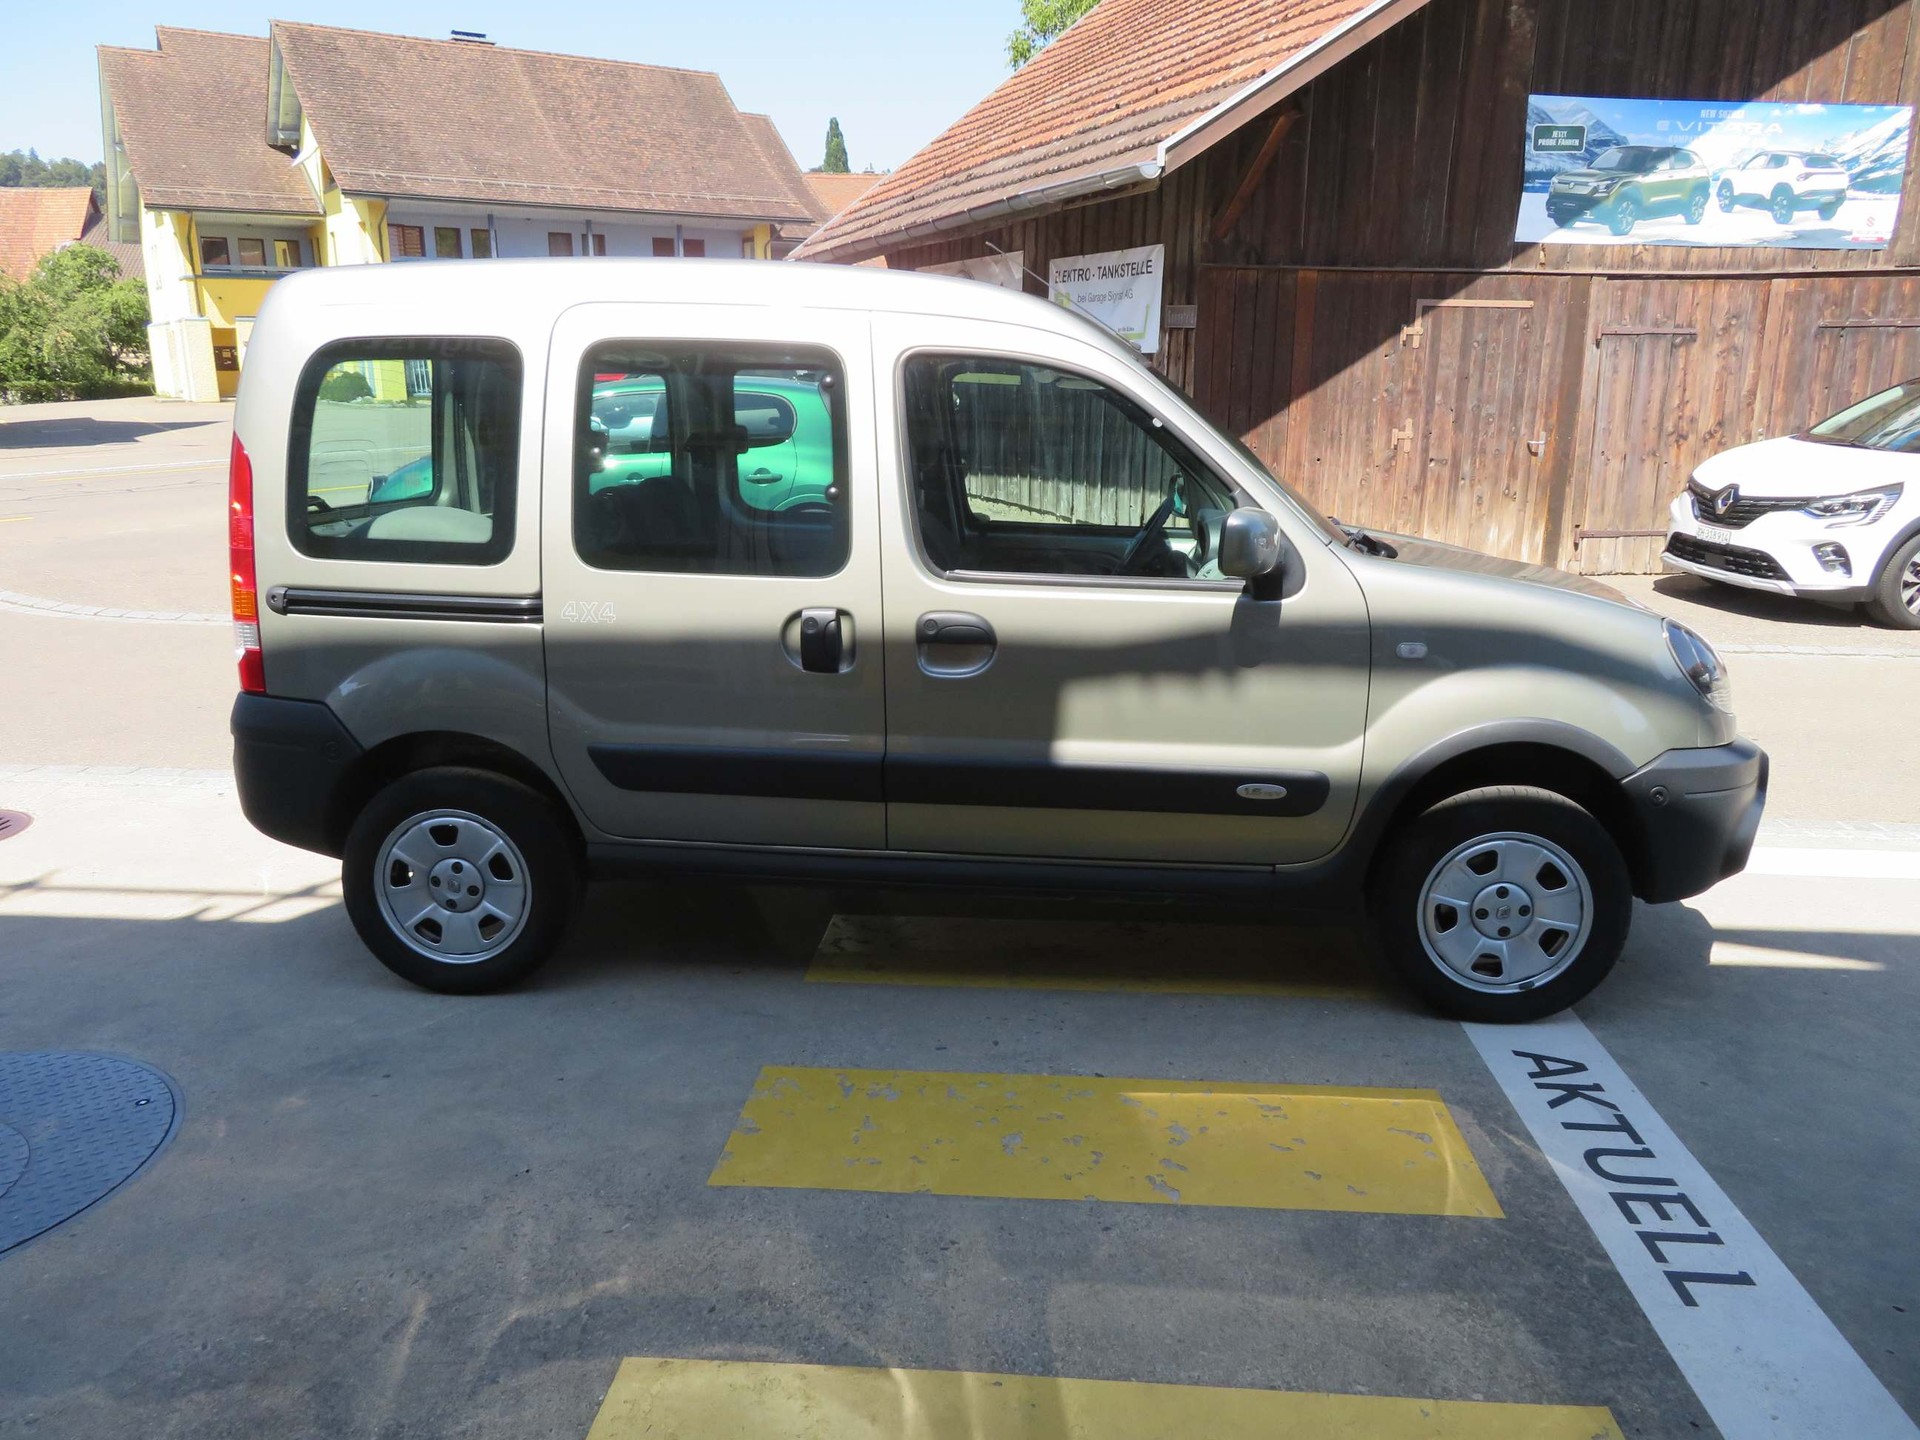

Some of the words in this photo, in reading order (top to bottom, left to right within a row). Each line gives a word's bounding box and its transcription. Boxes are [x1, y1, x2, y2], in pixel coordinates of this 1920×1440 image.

[1700, 109, 1717, 118] NEW
[1055, 267, 1091, 284] ELEKTRO
[1097, 259, 1153, 280] TANKSTELLE
[1087, 292, 1106, 304] Garage
[1124, 288, 1134, 299] AG
[1511, 1049, 1757, 1307] AKTUELL
